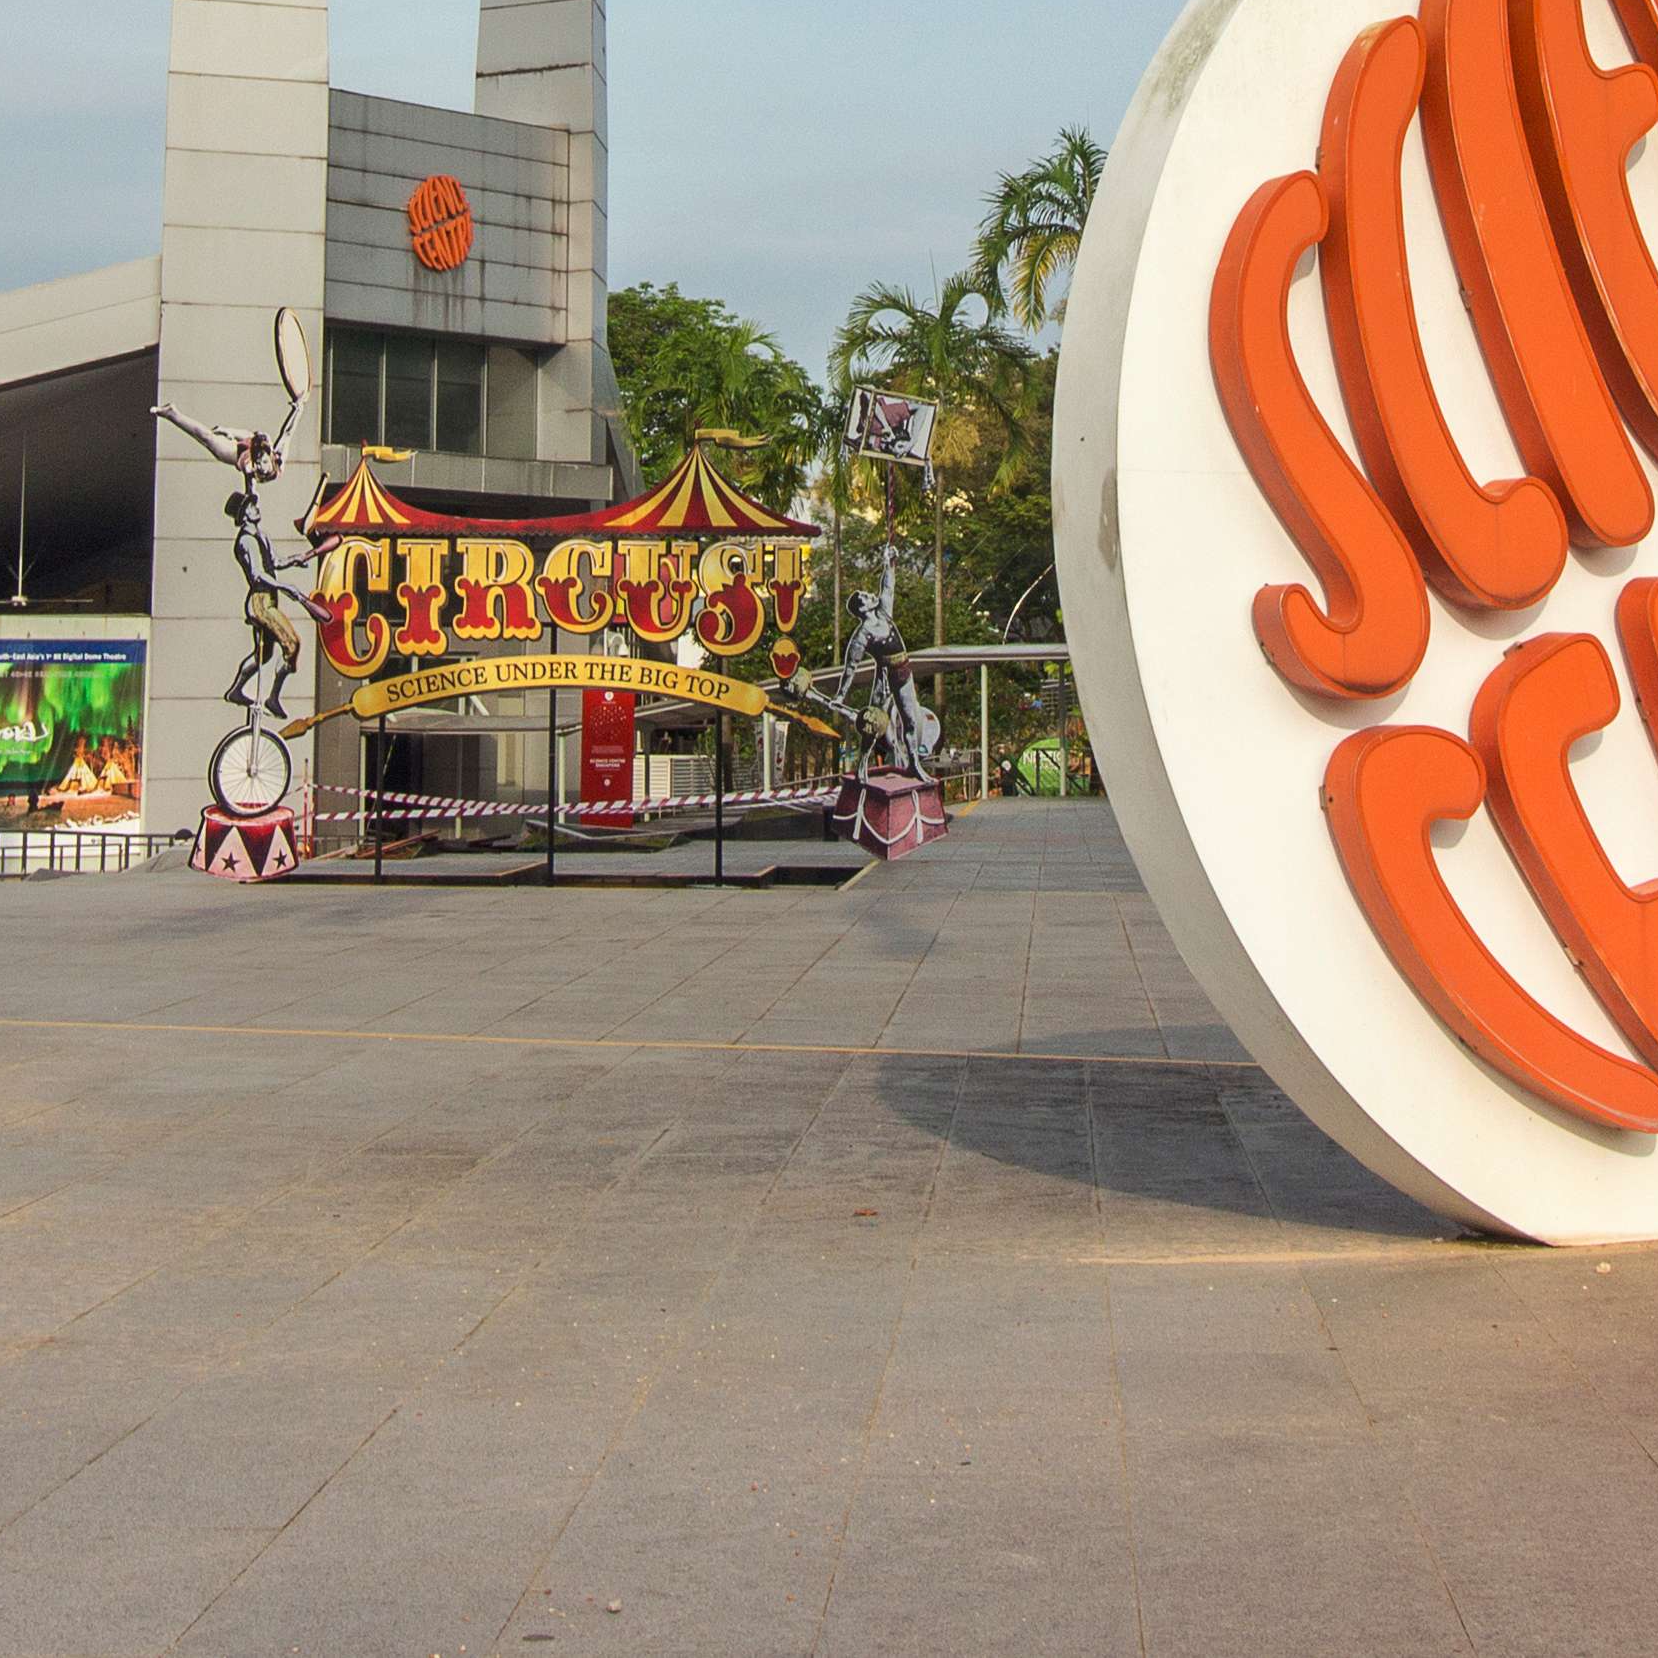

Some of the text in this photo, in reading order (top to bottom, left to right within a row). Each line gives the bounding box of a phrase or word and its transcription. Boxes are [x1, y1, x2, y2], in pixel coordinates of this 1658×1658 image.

[310, 536, 808, 679] CIRCUS!
[26, 652, 45, 661] Asia's
[63, 653, 83, 662] Digital
[84, 653, 102, 661] Dome
[387, 662, 730, 702] SCIENCE UNDER THE BIG TOP
